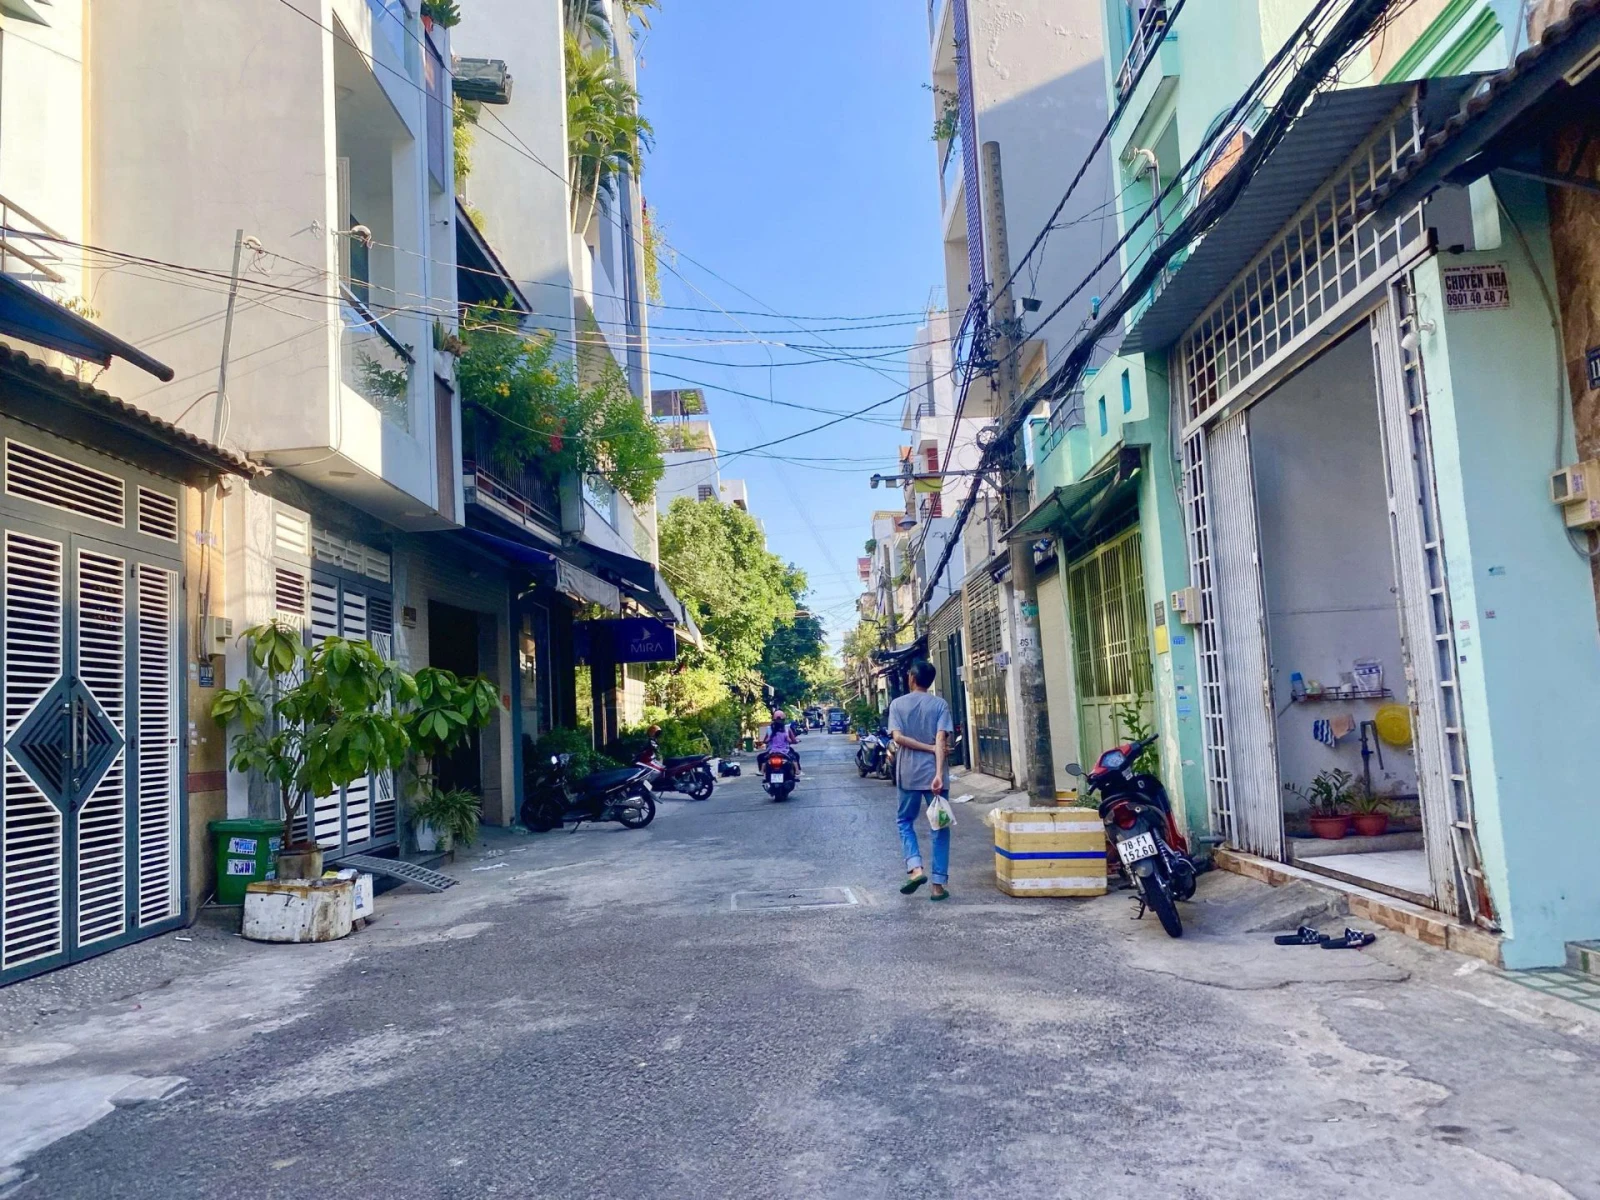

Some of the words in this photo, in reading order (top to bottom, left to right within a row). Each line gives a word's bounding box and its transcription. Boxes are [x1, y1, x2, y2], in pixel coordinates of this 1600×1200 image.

[1446, 293, 1468, 306] 0901
[1470, 291, 1482, 305] 40
[1498, 289, 1510, 302] 74
[630, 642, 663, 653] MIRA
[1123, 844, 1155, 863] 152.60
